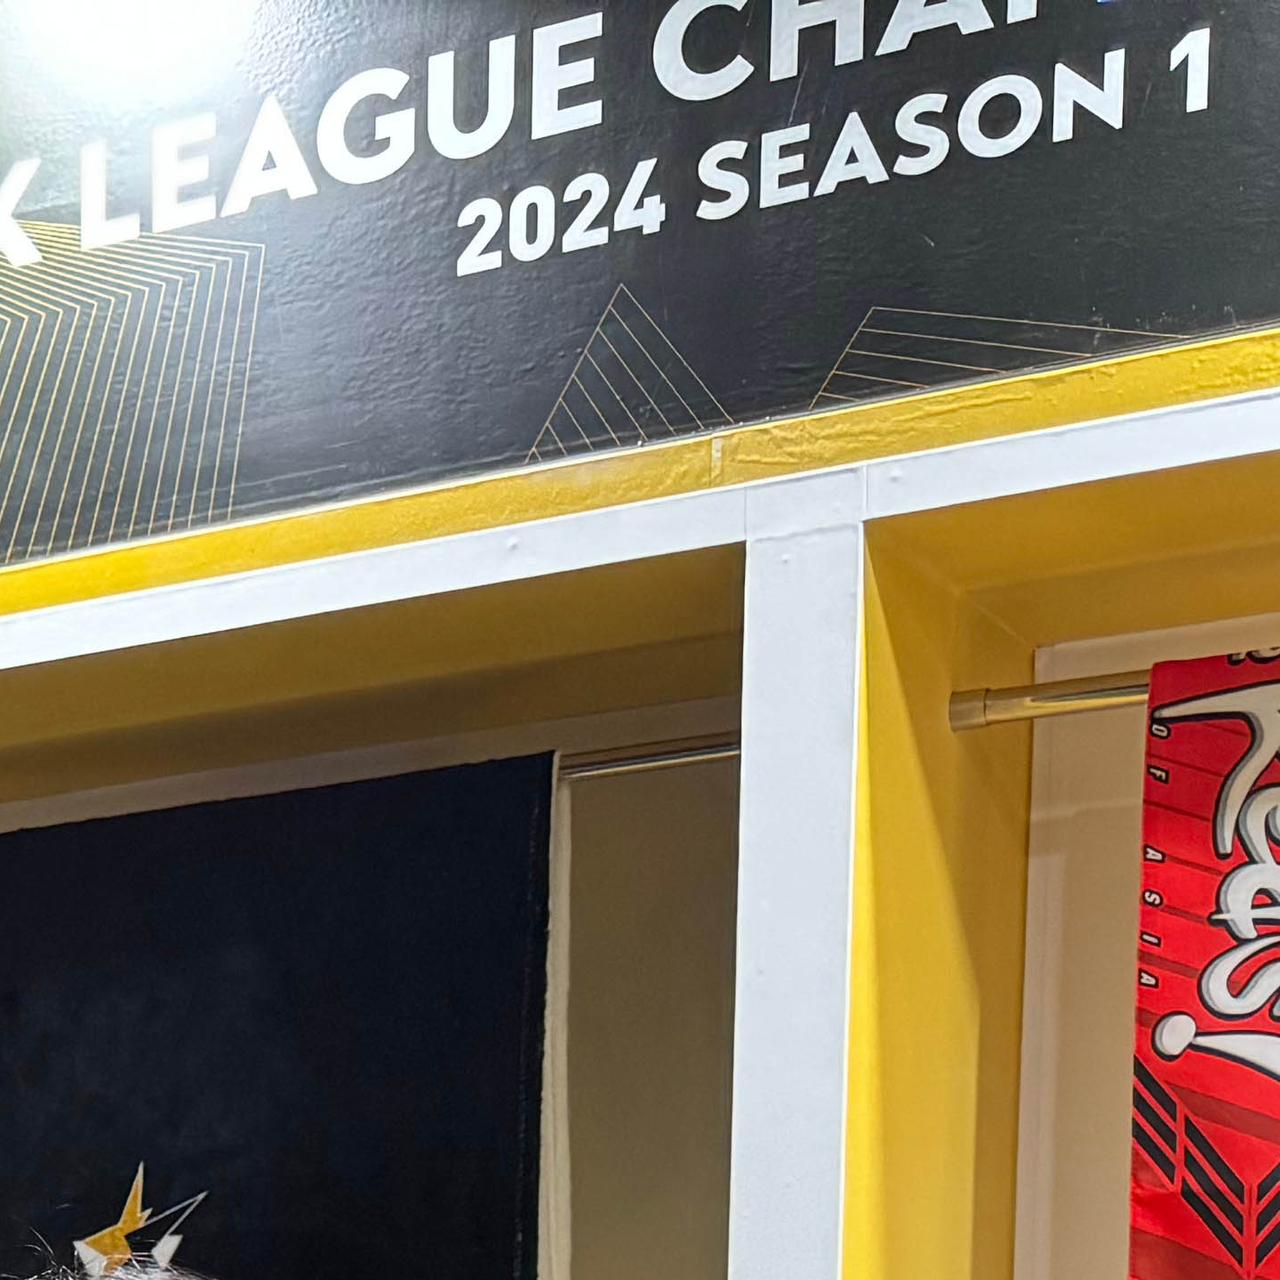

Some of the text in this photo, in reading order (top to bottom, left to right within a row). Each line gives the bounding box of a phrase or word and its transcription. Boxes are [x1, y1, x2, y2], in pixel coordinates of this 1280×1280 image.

[80, 12, 602, 251] LEAGUE
[653, 0, 1038, 101] CH
[456, 27, 1210, 276] 2024 SEASON 1
